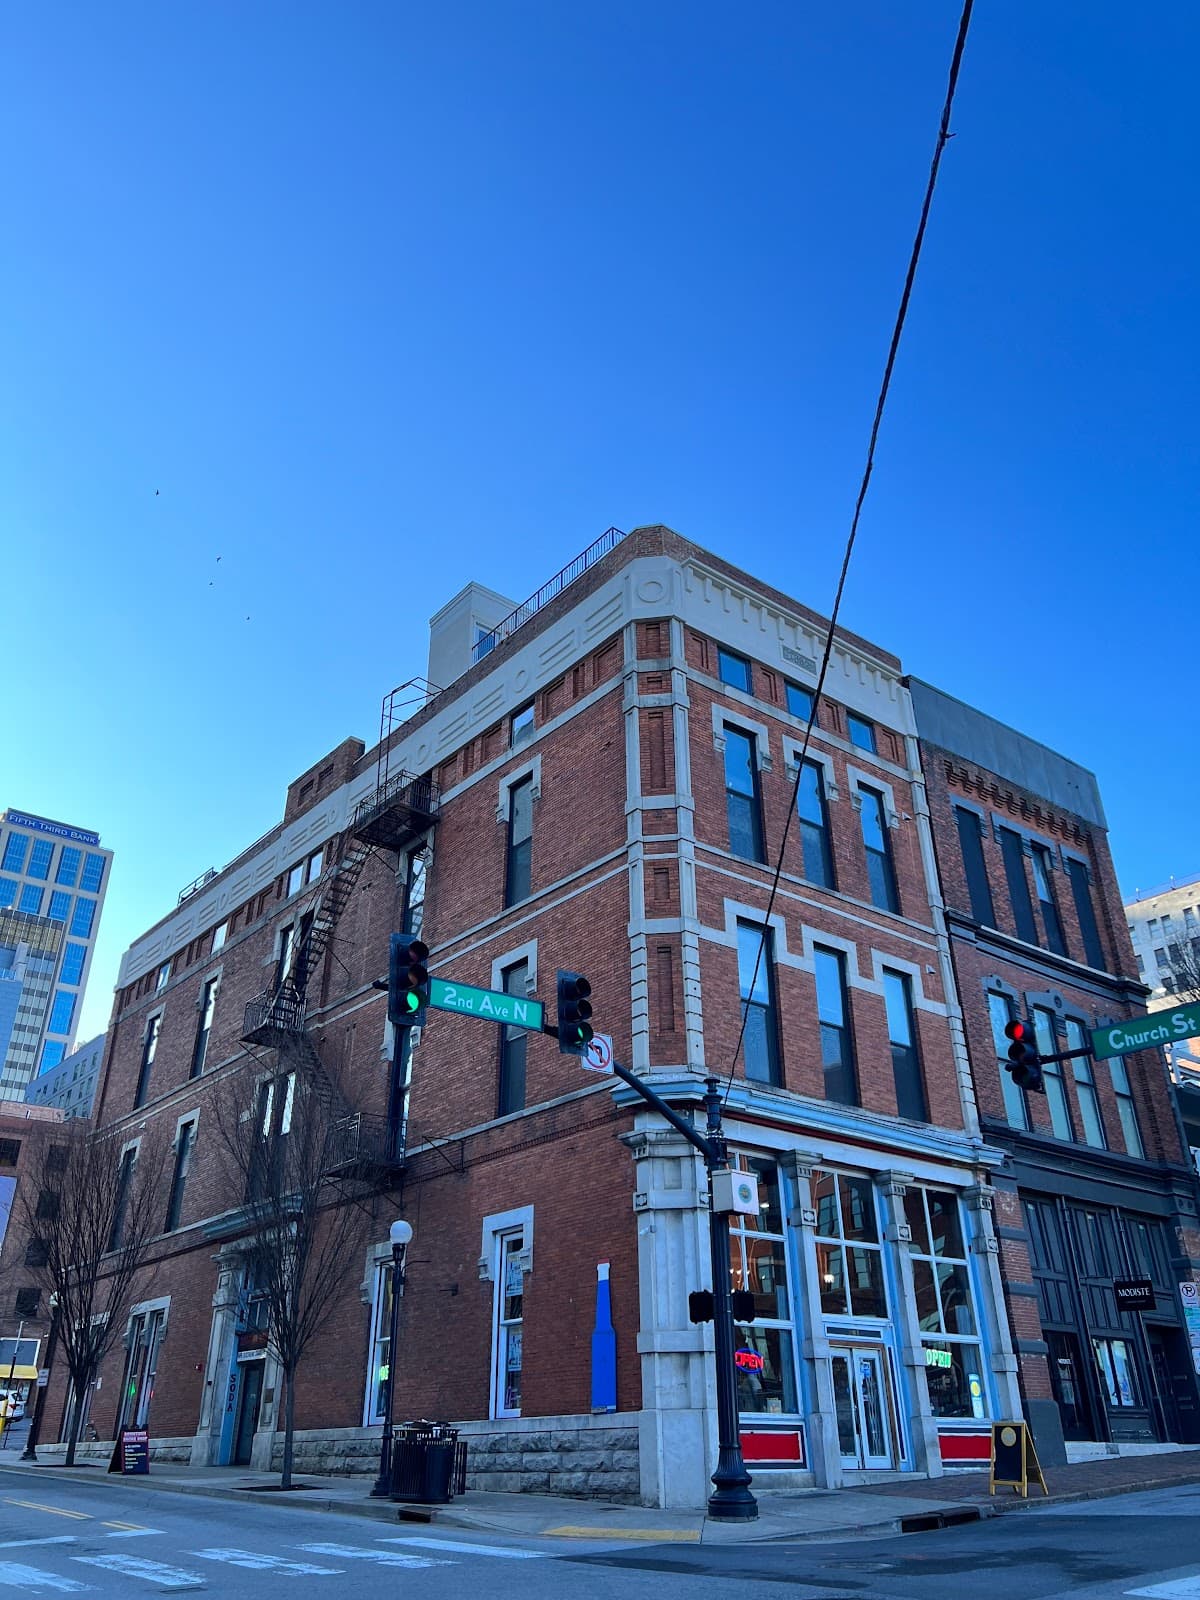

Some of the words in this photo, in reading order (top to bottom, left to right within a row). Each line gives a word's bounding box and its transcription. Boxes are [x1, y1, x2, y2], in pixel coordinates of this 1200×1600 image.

[10, 814, 36, 827] FIFTH
[39, 823, 68, 836] THIRD
[70, 832, 97, 844] BANK
[443, 987, 473, 1010] 2nd
[479, 995, 508, 1017] Ave
[514, 1001, 528, 1022] N
[1109, 1025, 1169, 1049] Church
[1171, 1013, 1197, 1034] St
[1118, 1287, 1150, 1297] MODISTE
[735, 1351, 764, 1371] OPEN
[925, 1348, 952, 1369] OPEN
[226, 1374, 237, 1412] SODA
